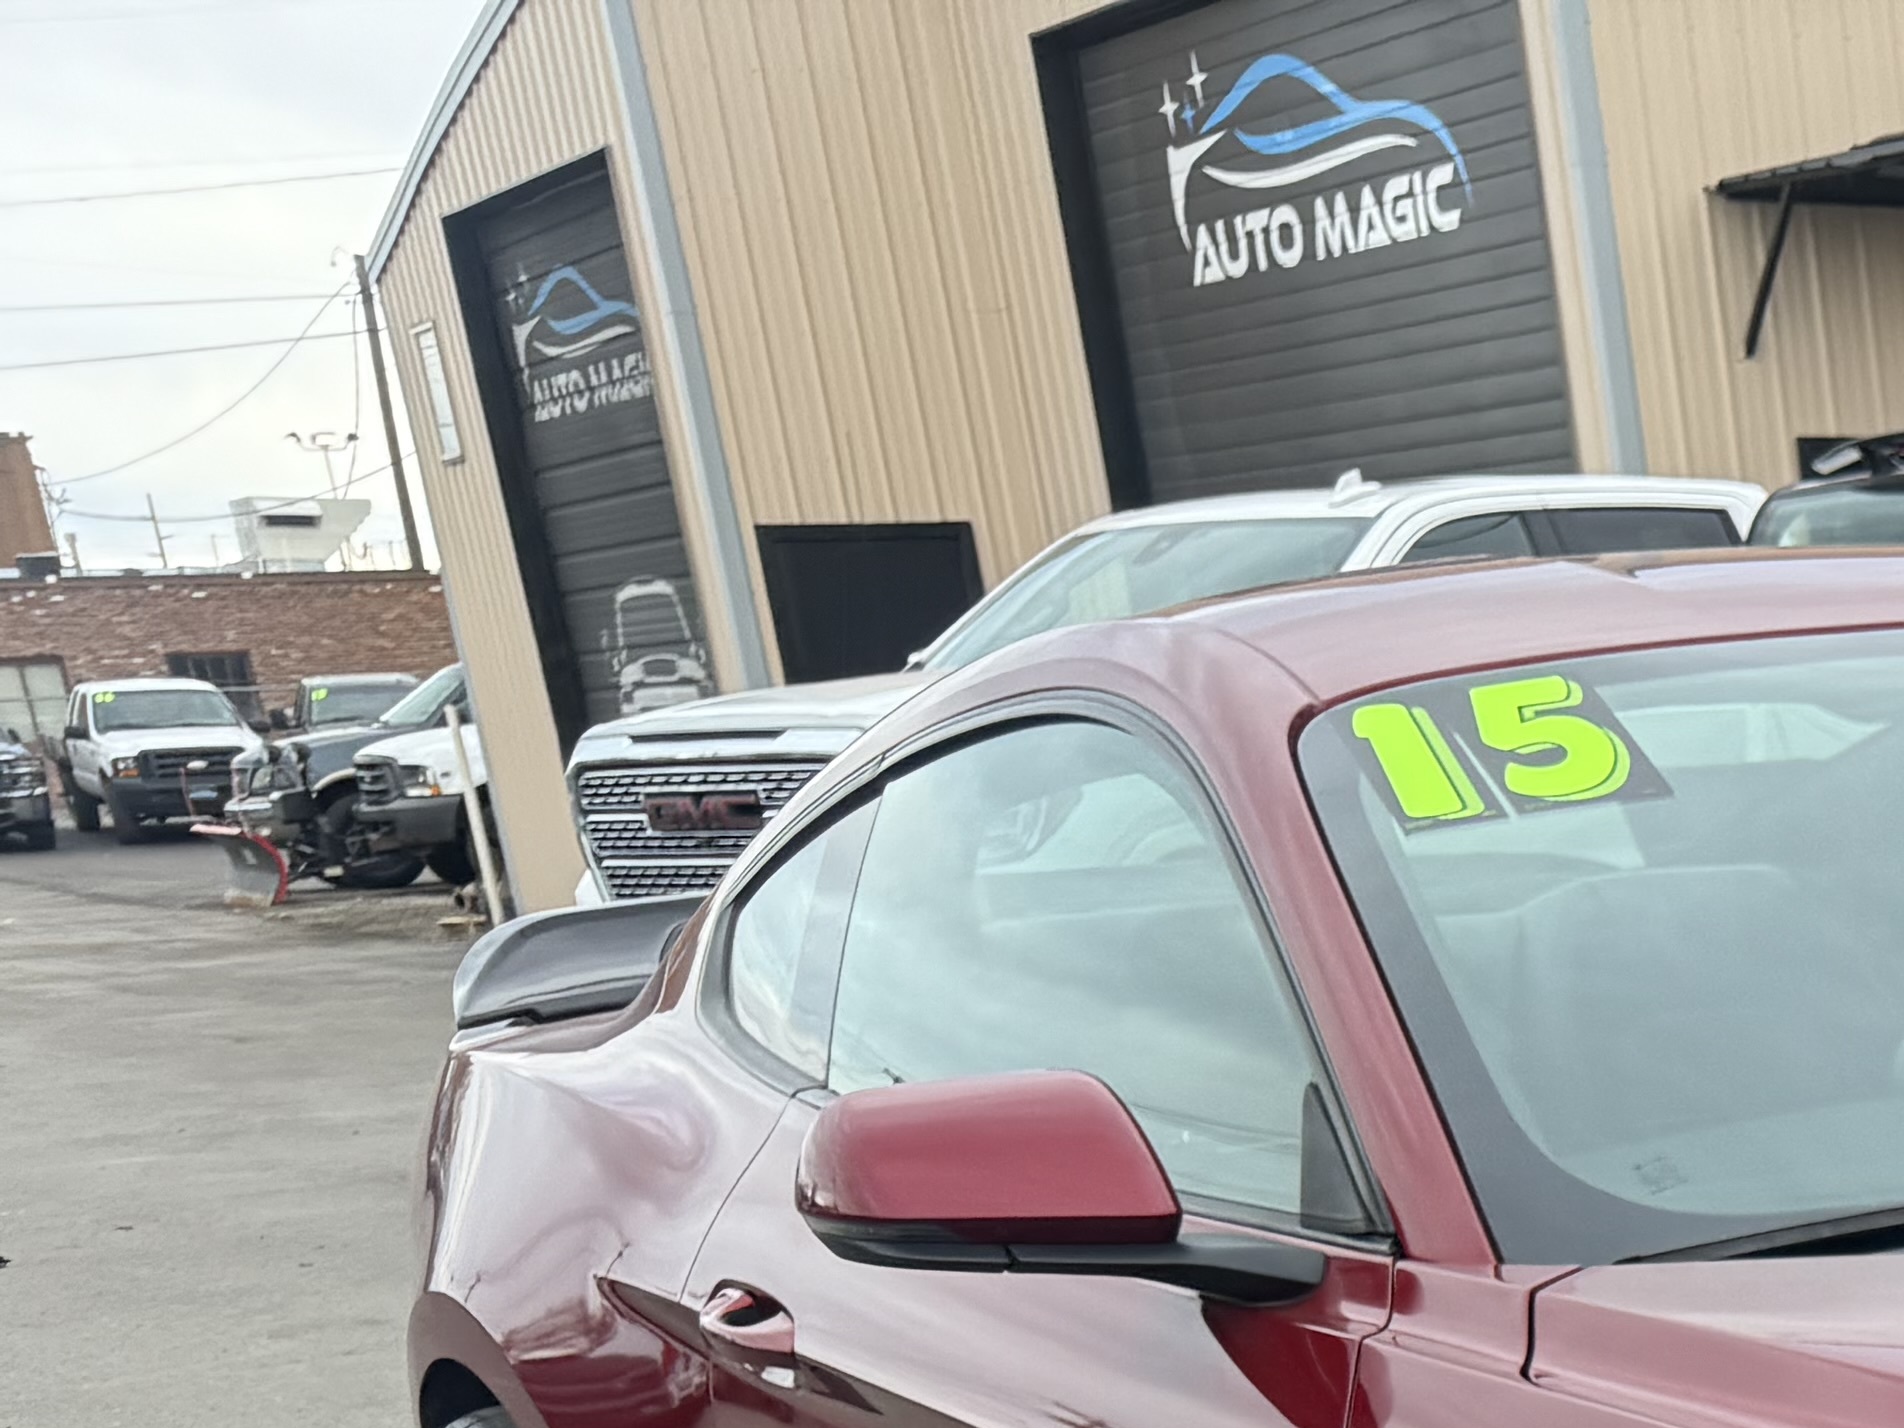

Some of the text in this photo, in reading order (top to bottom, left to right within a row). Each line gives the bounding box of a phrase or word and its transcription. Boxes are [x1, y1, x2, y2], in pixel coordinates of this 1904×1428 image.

[1193, 162, 1462, 287] AUTO MAGIC
[533, 369, 590, 422] AUTO
[1352, 675, 1631, 820] 15
[644, 791, 762, 832] GMC
